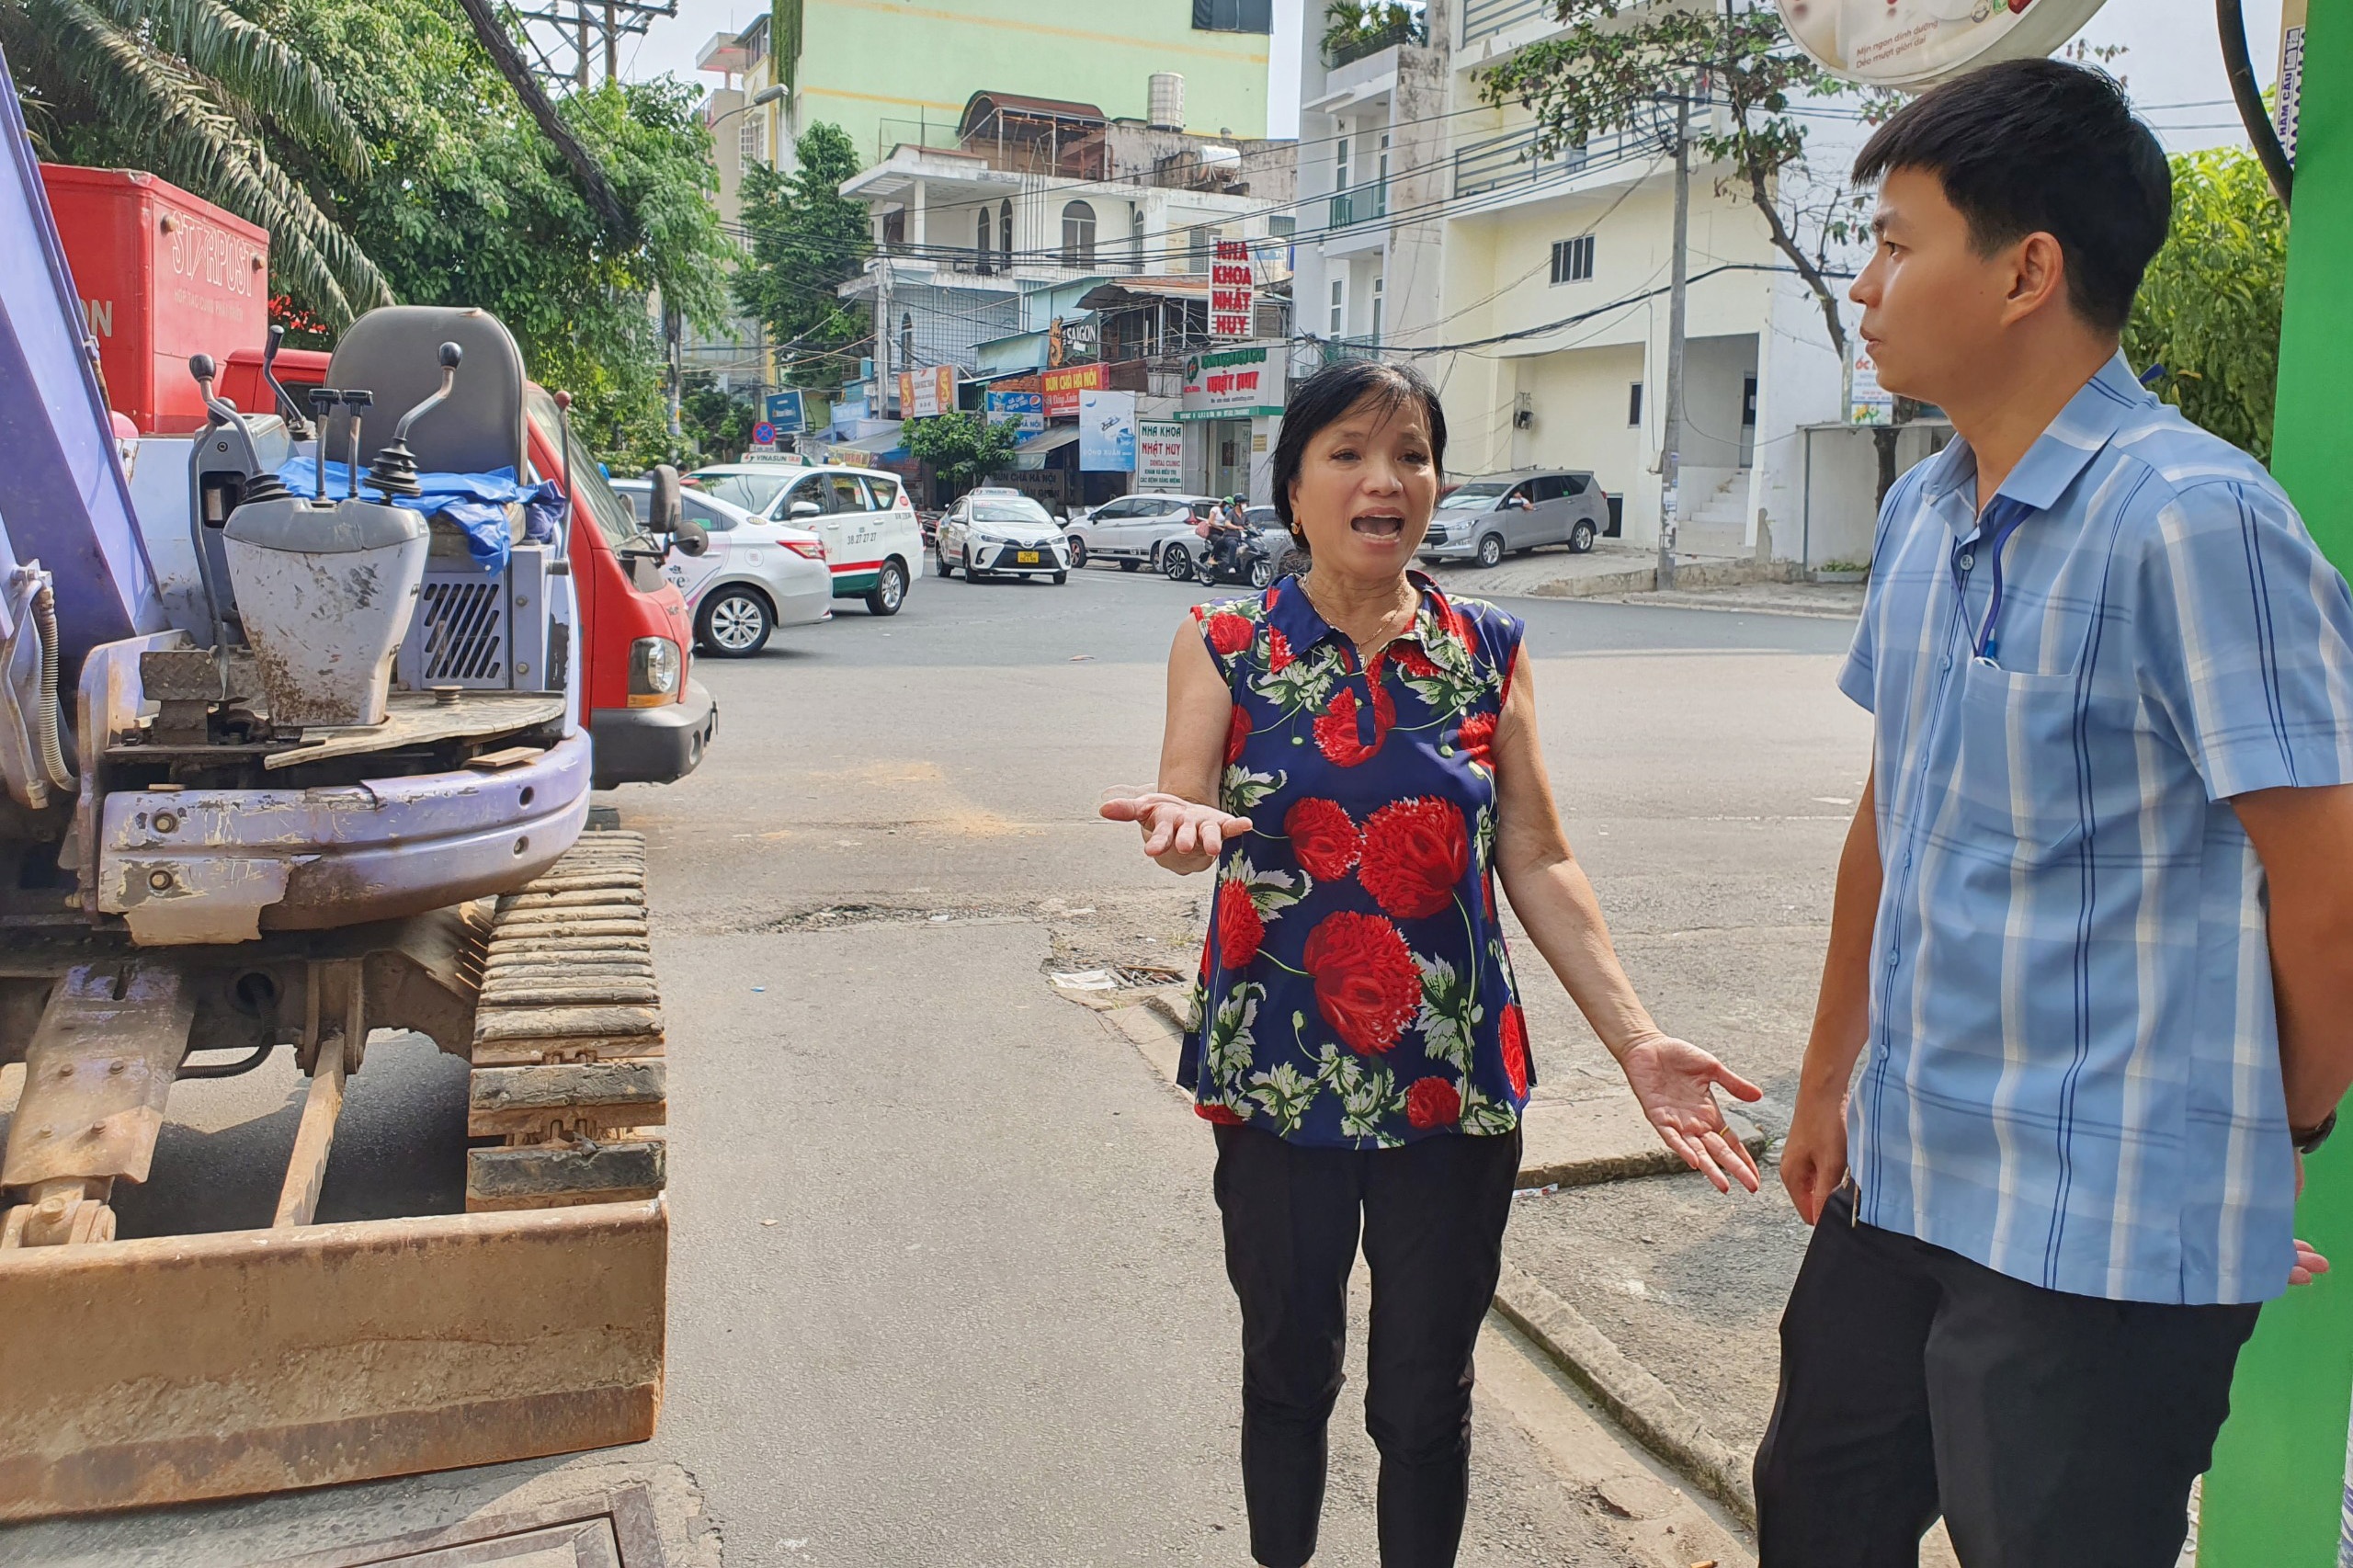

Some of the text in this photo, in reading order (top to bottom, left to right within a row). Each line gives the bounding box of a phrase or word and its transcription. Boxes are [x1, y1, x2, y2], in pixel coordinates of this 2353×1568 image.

[1857, 20, 1938, 57] Mịn ngon dinh dưỡng
[1872, 50, 1893, 62] mượt
[1217, 240, 1248, 261] NHA
[1212, 265, 1252, 285] KHOA
[1067, 324, 1097, 345] SAIGON
[1216, 314, 1247, 335] HUY
[1084, 368, 1097, 390] NỘI
[1236, 371, 1259, 392] HUY
[1142, 426, 1181, 437] NHA KHOA
[1142, 441, 1181, 458] NHẬT HUY
